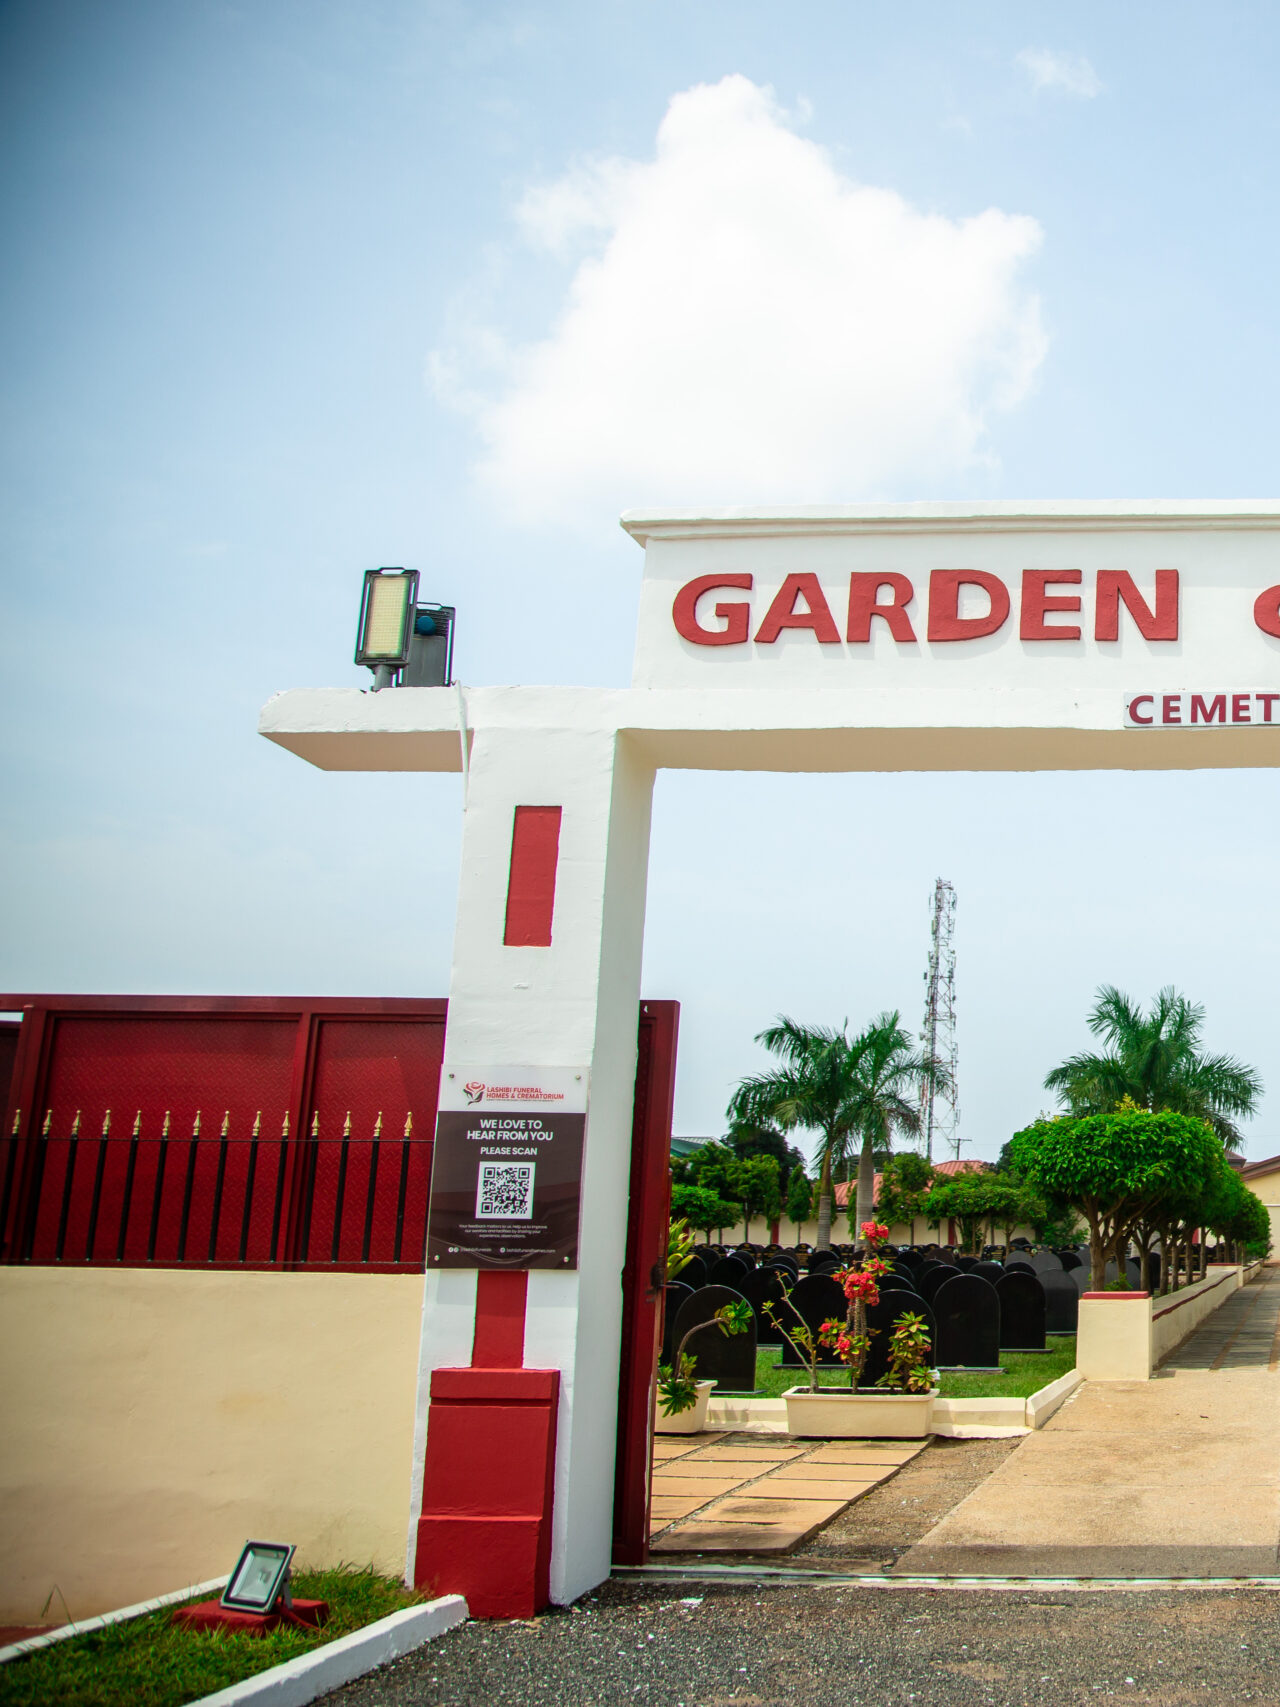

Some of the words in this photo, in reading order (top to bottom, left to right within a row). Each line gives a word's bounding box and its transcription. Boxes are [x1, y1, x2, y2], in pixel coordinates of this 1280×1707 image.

[673, 570, 1179, 646] GARDEN
[480, 1119, 498, 1129] WE
[498, 1119, 526, 1129] LOVE
[527, 1119, 543, 1129] TO
[467, 1130, 495, 1140] HEAR
[497, 1130, 529, 1141] FROM
[530, 1131, 554, 1141] YOU
[480, 1146, 511, 1155] PLEASE
[512, 1147, 538, 1156] SCAN
